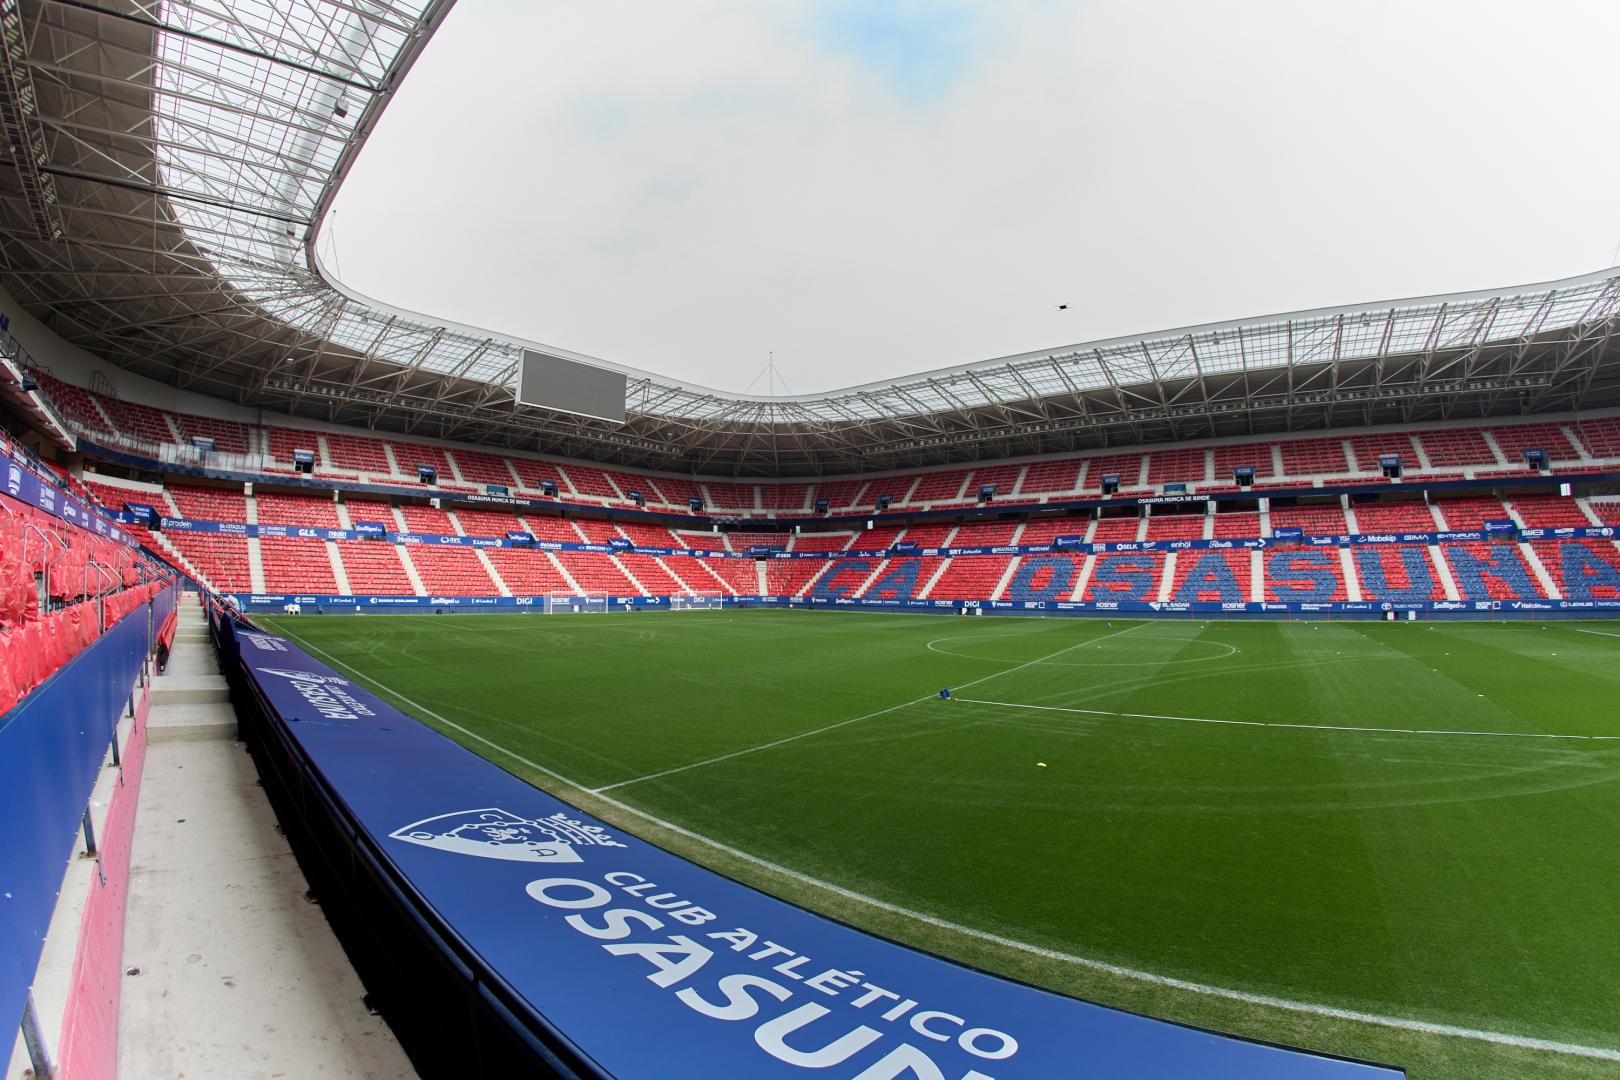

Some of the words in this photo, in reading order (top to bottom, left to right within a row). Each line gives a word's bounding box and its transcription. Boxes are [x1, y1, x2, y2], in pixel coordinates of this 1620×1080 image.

[467, 494, 491, 502] OSASUNA
[289, 680, 359, 720] OSASUNA
[603, 871, 717, 926] CLUB
[706, 926, 1019, 1060] ATLÉTICO
